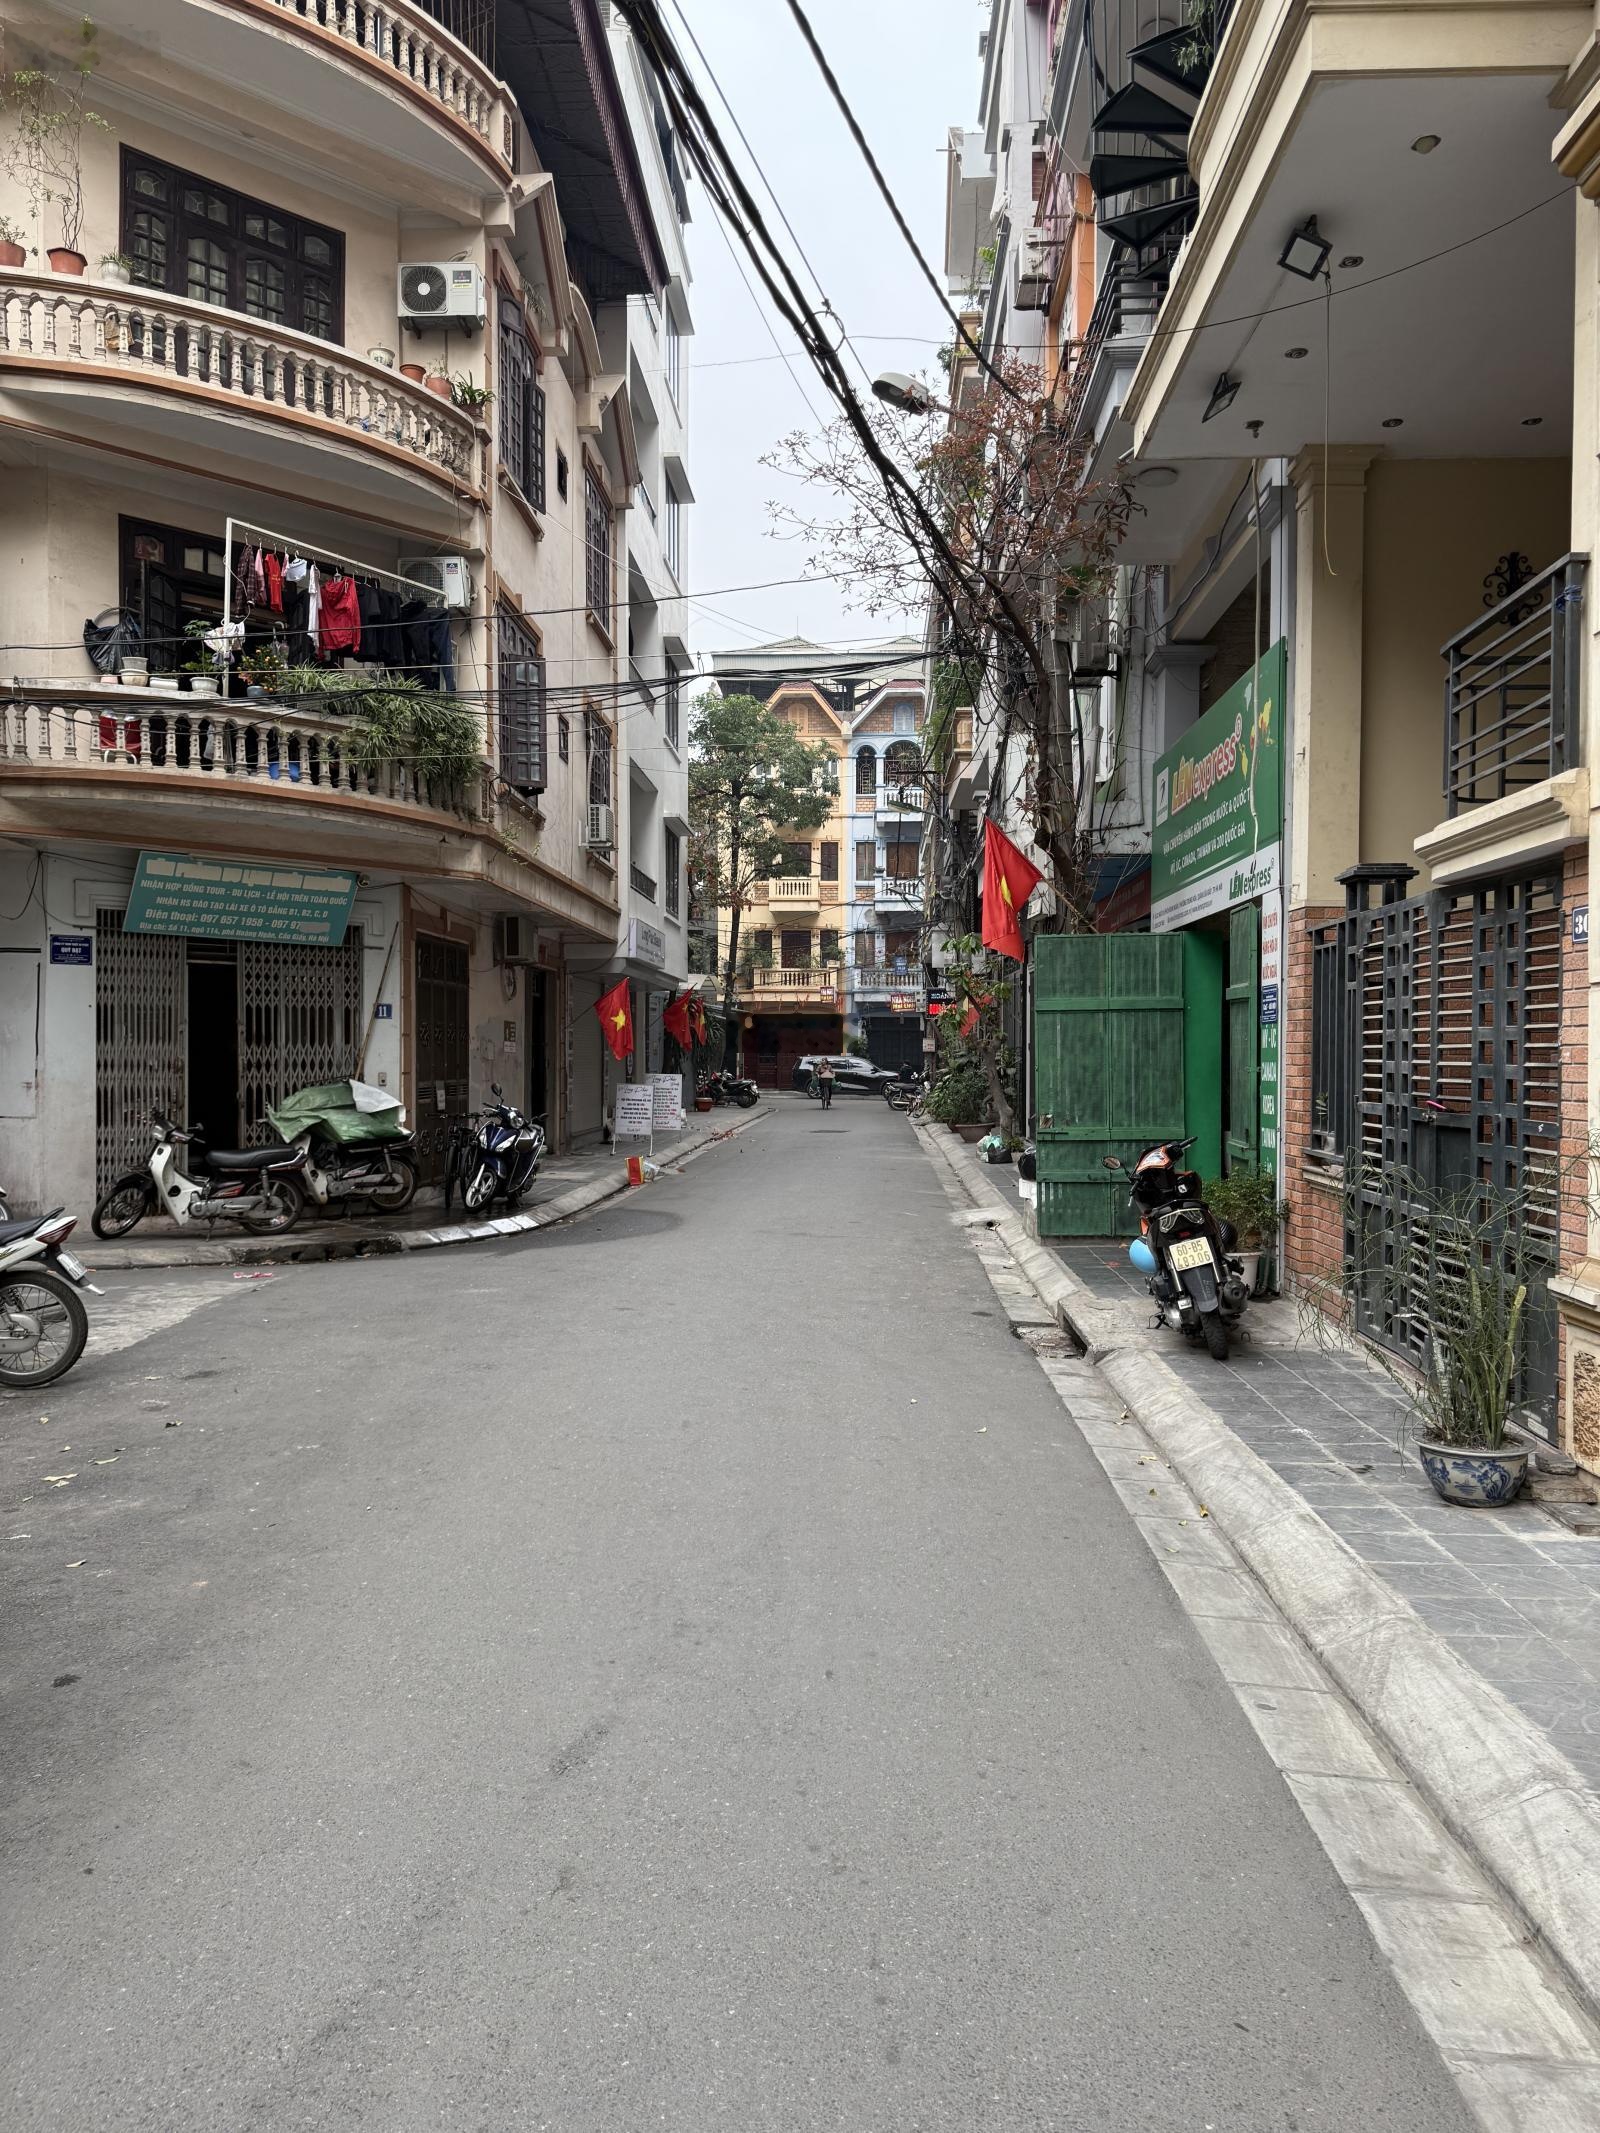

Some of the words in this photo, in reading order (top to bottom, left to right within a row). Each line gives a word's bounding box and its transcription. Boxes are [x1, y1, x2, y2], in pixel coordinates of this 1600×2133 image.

[1233, 786, 1247, 812] QUỐC
[206, 886, 226, 895] TOUR
[244, 890, 260, 900] LỊCH
[291, 893, 310, 903] TRÊN
[210, 901, 225, 910] TẠO
[240, 904, 249, 912] XE
[145, 908, 168, 920] Điện
[200, 914, 219, 923] 097
[271, 919, 289, 929] 097
[379, 1006, 387, 1017] 11
